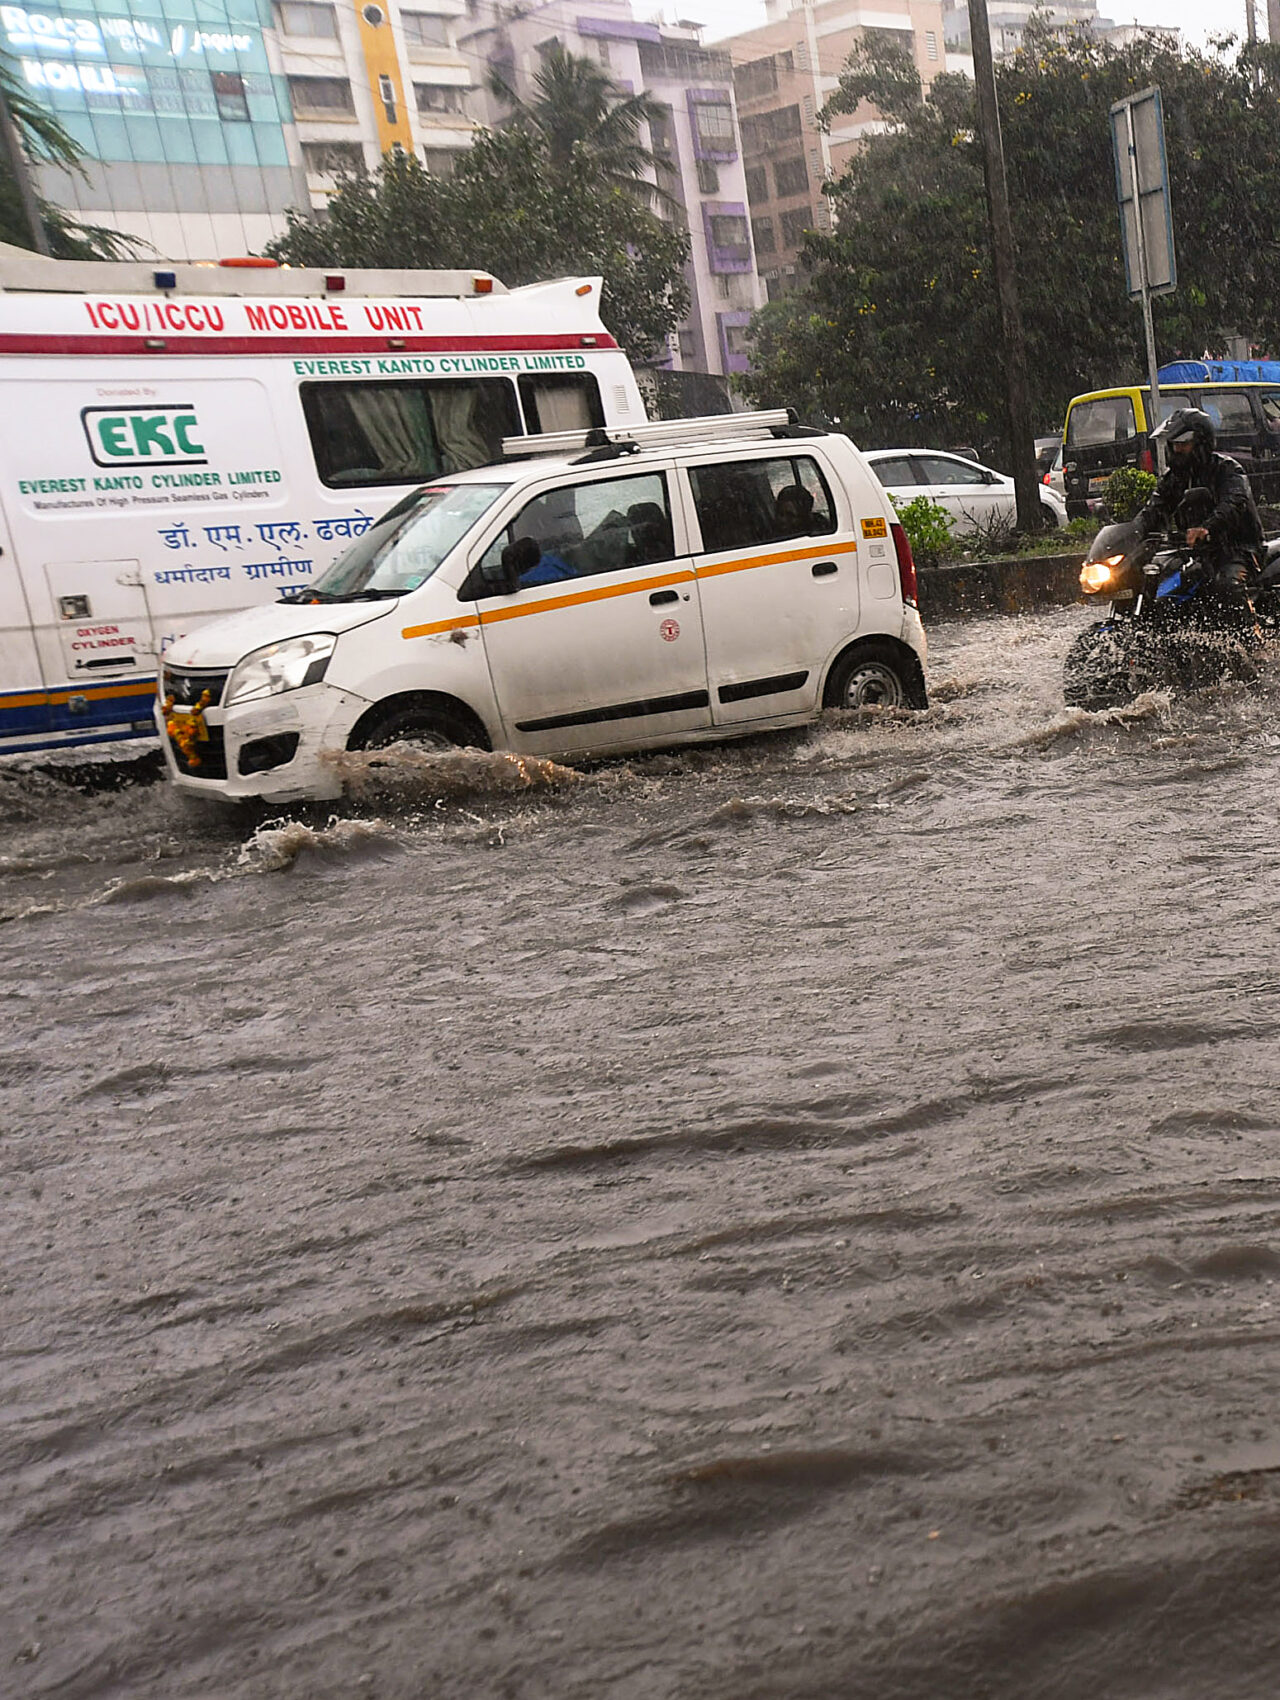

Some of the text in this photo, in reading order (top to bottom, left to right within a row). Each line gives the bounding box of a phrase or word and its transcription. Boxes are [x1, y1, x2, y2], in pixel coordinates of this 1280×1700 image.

[0, 5, 100, 41] Roca
[84, 302, 424, 331] ICU/ICCU MOBILE UNIT
[293, 355, 586, 375] EVEREST KANTO CYLINDER LIMITED
[97, 415, 205, 457] EKC
[18, 470, 282, 495] EVEREST KANTO CYLINDER LIMITED
[212, 490, 228, 501] Gas
[232, 489, 270, 501] Cylinders
[154, 563, 231, 584] धर्मादाय
[242, 556, 314, 581] ग्रामीण
[72, 637, 136, 650] CYLINDER
[77, 625, 120, 637] OXYGEN
